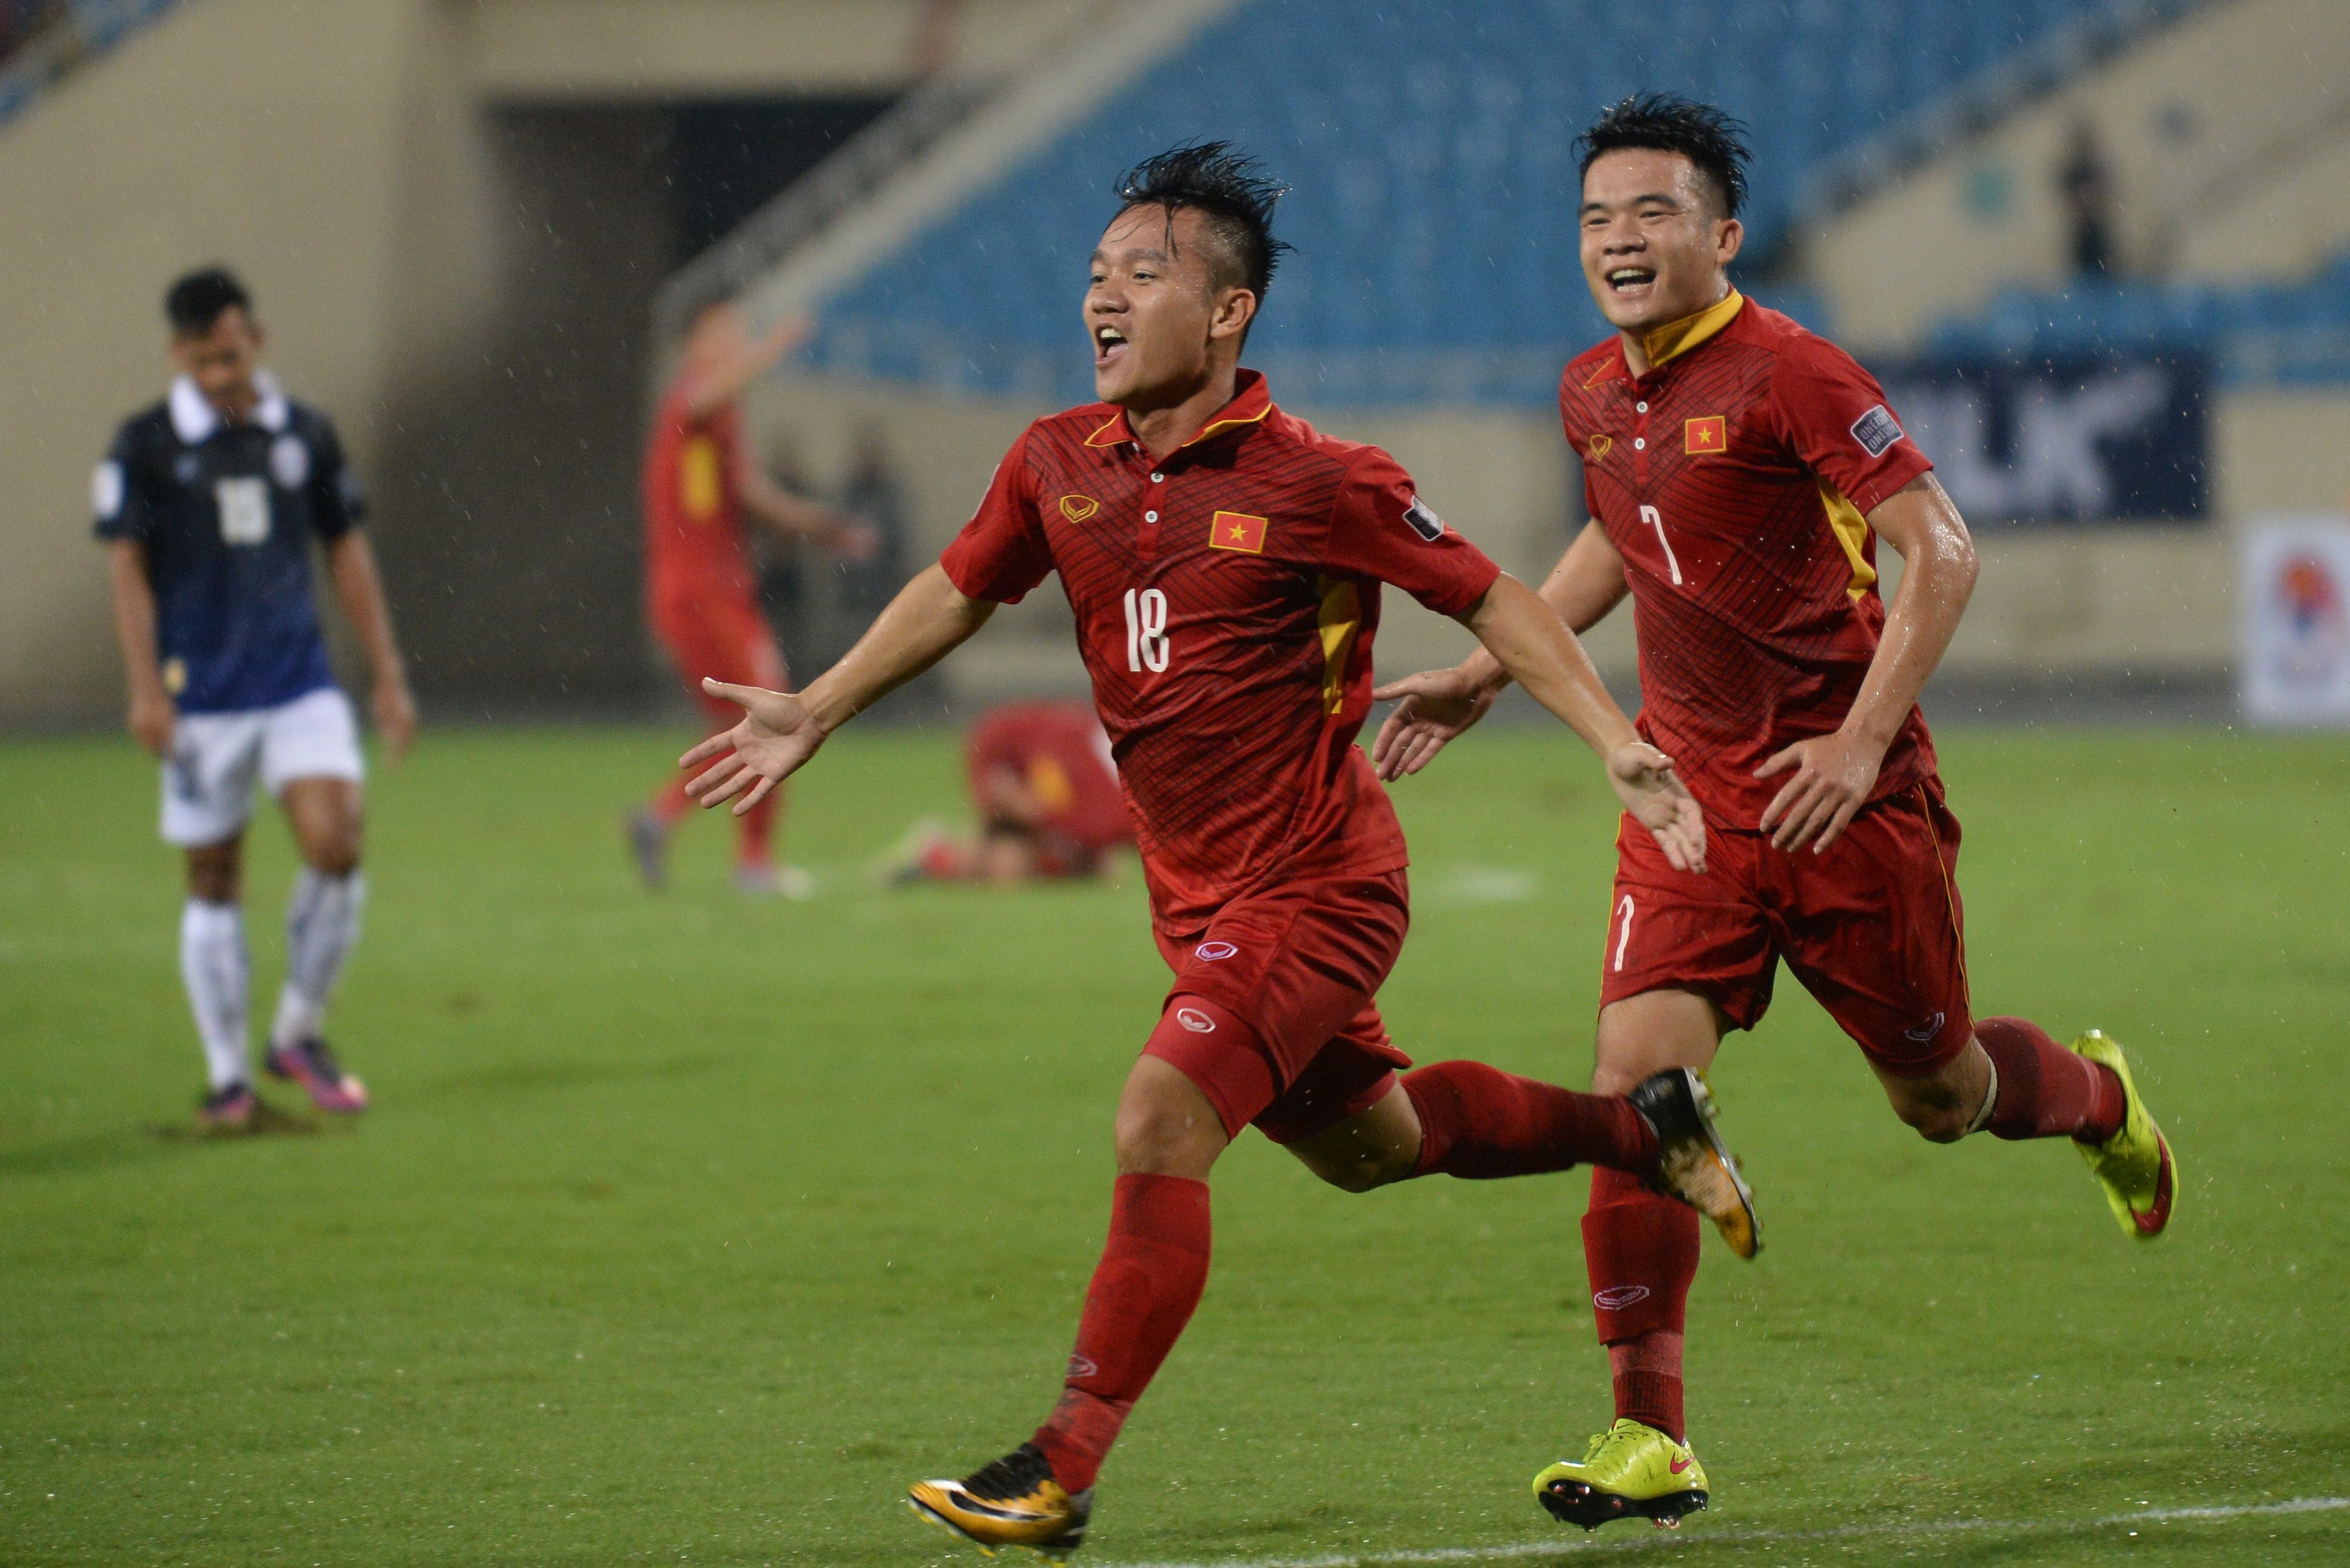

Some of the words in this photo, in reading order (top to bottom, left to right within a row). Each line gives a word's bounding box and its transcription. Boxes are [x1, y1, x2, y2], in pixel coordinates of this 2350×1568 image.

[1639, 505, 1682, 585] 7
[1124, 588, 1169, 672] 18
[1614, 894, 1634, 972] 7
